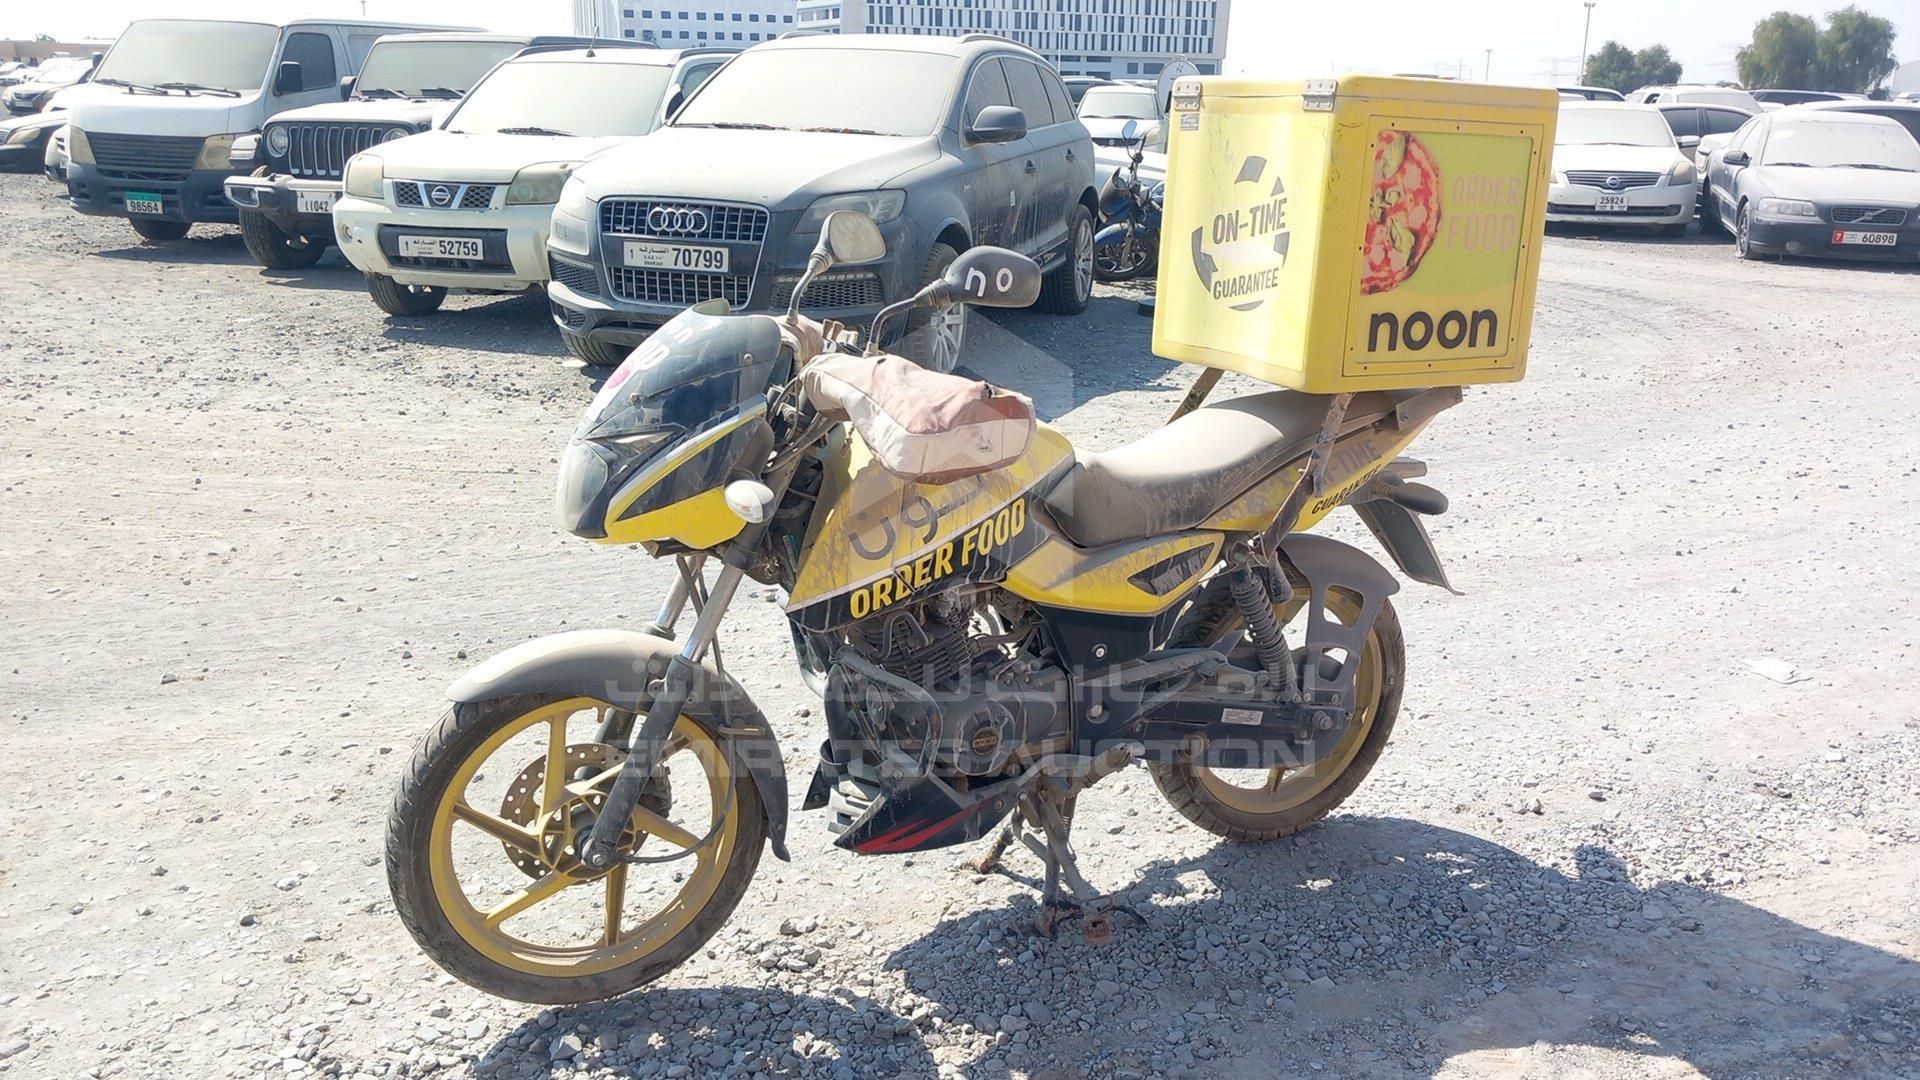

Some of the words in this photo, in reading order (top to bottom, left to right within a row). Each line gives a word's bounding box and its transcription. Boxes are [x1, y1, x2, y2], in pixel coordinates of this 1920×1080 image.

[1452, 176, 1521, 206] ORDER
[1600, 197, 1624, 205] 25924
[130, 201, 159, 212] 98564
[305, 200, 329, 212] 11042
[1212, 197, 1288, 245] ON-TIME
[1447, 212, 1517, 251] FOOD
[439, 240, 478, 256] 52759
[1862, 234, 1895, 244] 60898
[672, 248, 724, 269] 70799
[1213, 267, 1280, 300] GUARANTEE
[1367, 308, 1498, 352] noon
[850, 542, 954, 619] ORDER
[961, 498, 1025, 566] FOOD
